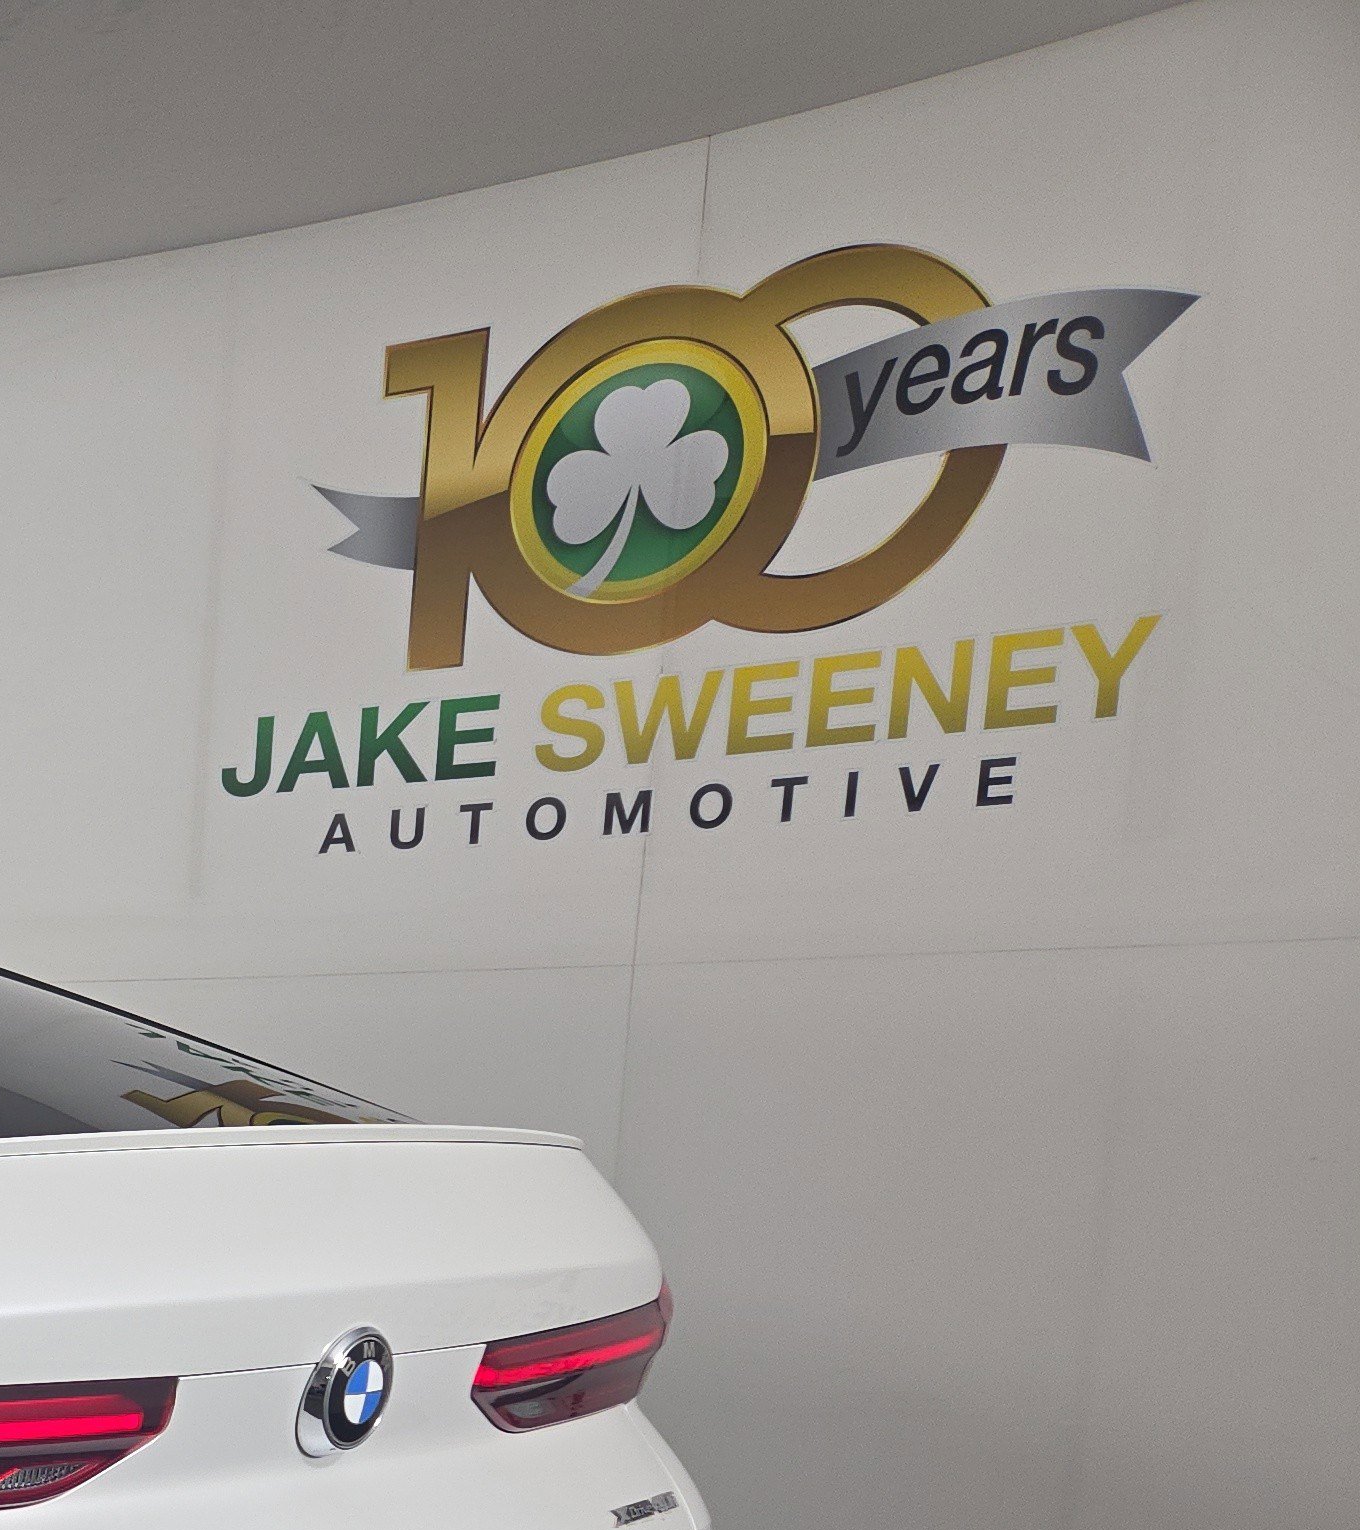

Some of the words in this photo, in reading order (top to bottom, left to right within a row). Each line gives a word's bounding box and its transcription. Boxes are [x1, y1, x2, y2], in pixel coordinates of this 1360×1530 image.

[383, 243, 1007, 671] 100
[836, 314, 1104, 458] years
[221, 694, 501, 796] JAKE
[534, 614, 1162, 772] SWEENEY
[318, 755, 1018, 854] AUTOMOTIVE
